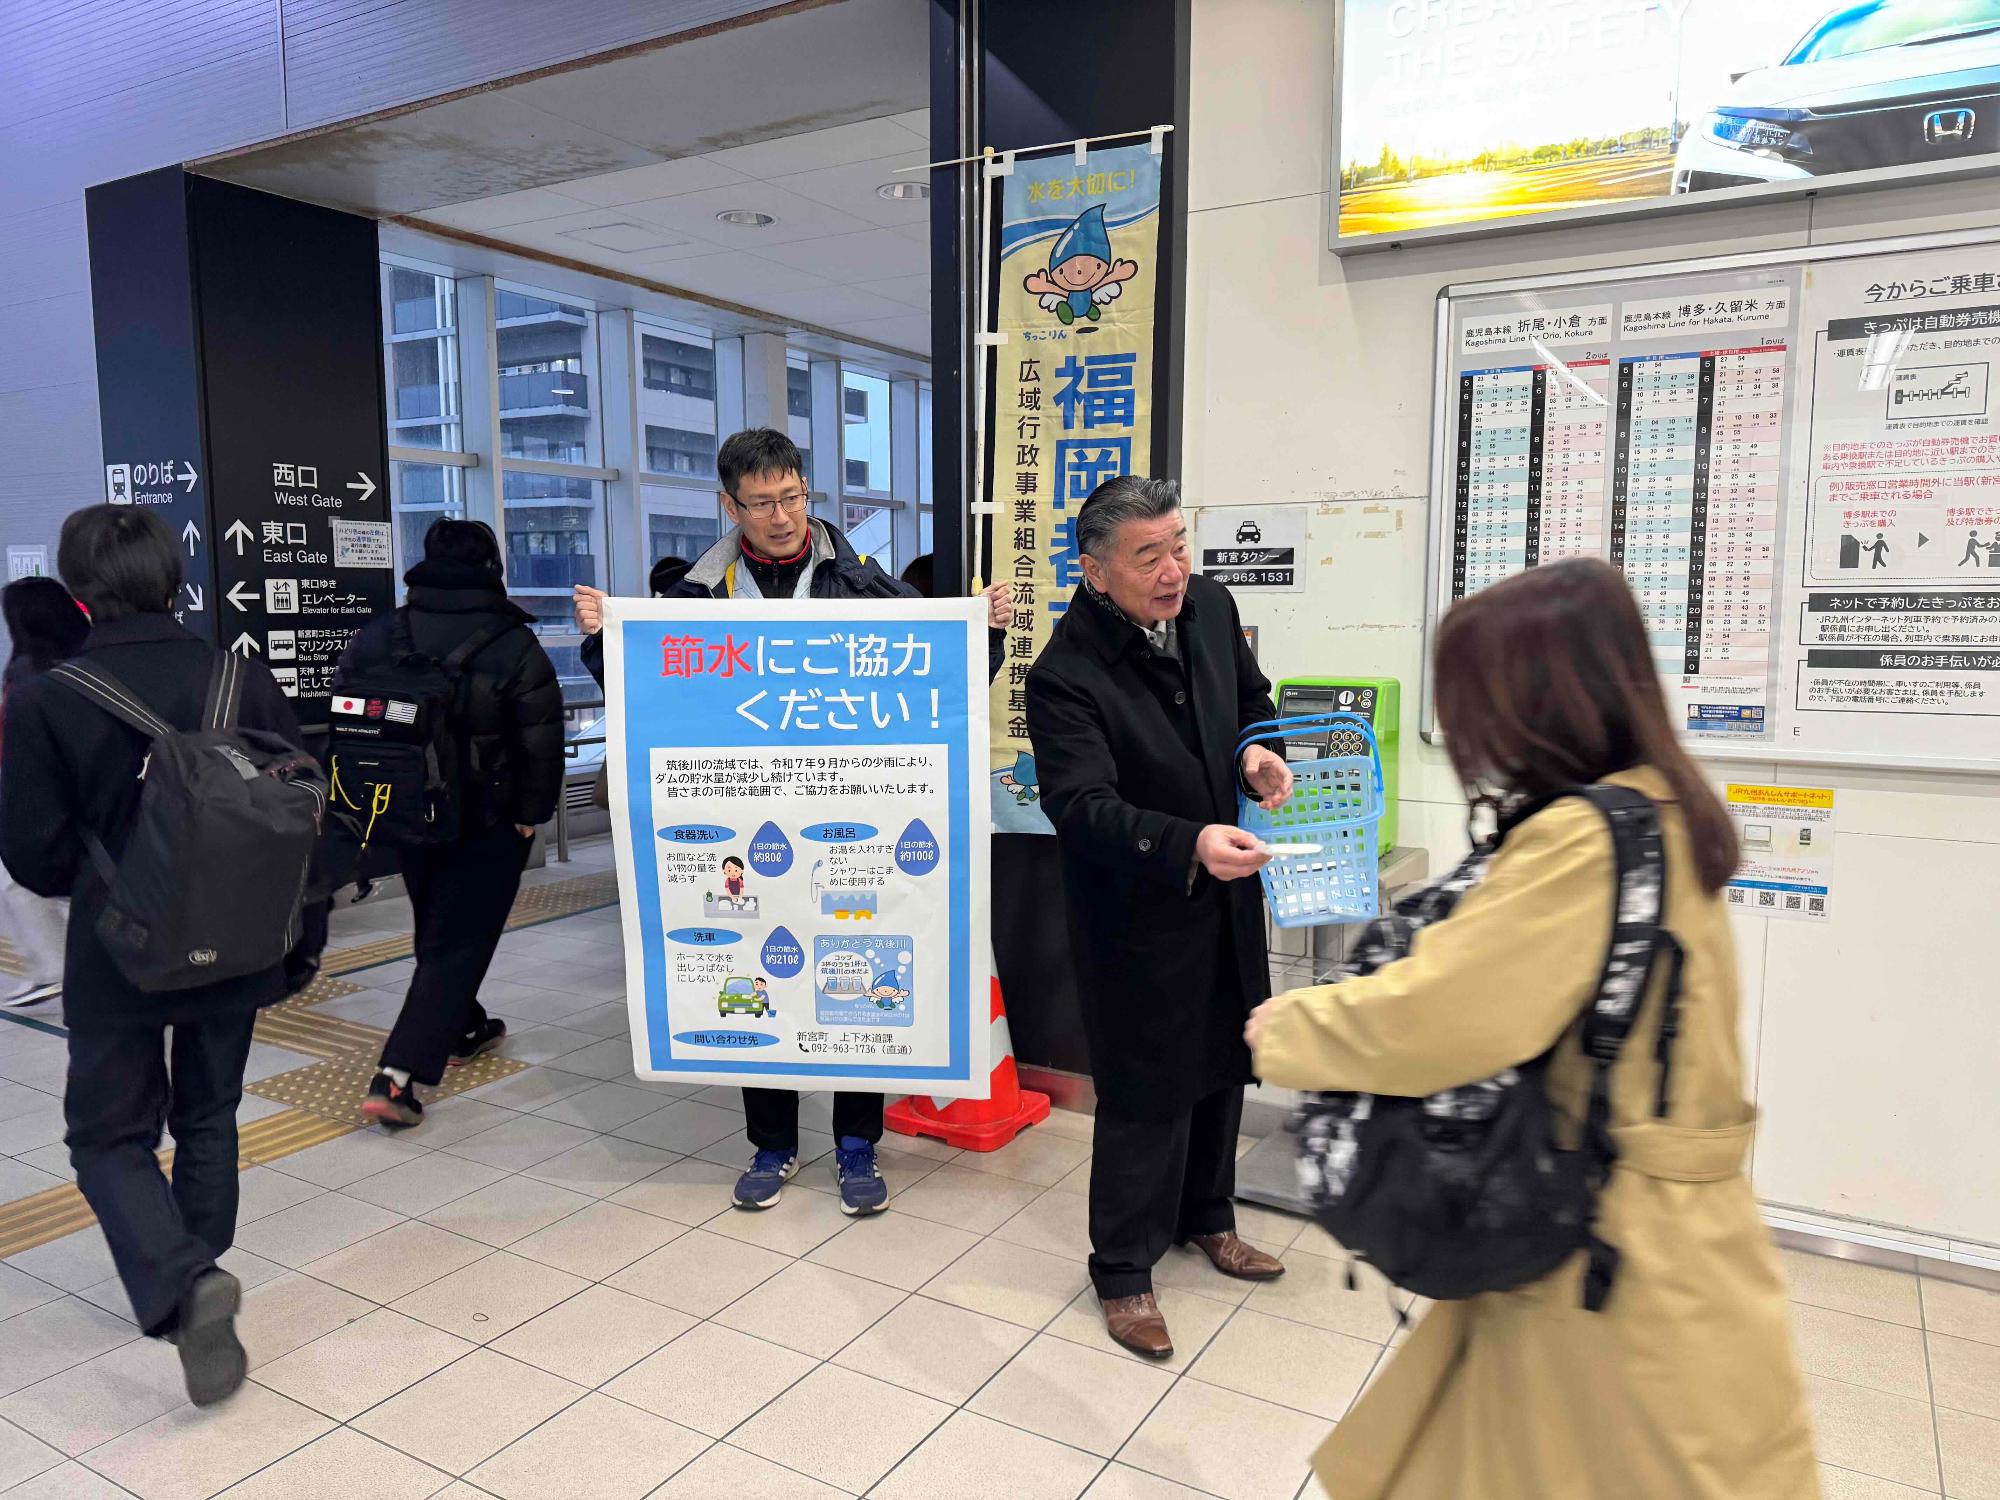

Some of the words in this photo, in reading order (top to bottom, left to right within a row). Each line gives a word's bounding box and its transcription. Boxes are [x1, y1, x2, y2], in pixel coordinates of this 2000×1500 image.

[1385, 0, 1575, 38] CREA
[1865, 273, 2000, 302] 今からご乗車
[1678, 299, 1758, 319] 博多・久留米
[1765, 300, 1786, 311] 方面
[1518, 315, 1581, 332] 折尾・小倉
[1588, 315, 1608, 326] 方面
[1624, 322, 1666, 333] Kagoshima
[1668, 320, 1686, 329] Line
[1688, 318, 1701, 327] for
[1737, 312, 1769, 323] Kurume
[1022, 330, 1068, 341] ちっこりん
[1465, 337, 1506, 348] Kagoshima
[1509, 335, 1527, 344] Line
[1564, 329, 1594, 339] Kokura
[1703, 397, 1708, 405] 7
[1823, 434, 2000, 452] ※目的地までのきっぷが自動券売機でお買
[133, 460, 174, 486] のりば
[273, 462, 319, 490] 西口
[135, 492, 173, 504] Entrance
[1048, 352, 1137, 633] 福岡
[274, 491, 308, 507] West
[311, 494, 343, 509] Gate
[261, 522, 307, 546] 東口
[263, 549, 293, 564] East
[295, 551, 328, 564] Gate
[1217, 551, 1280, 564] 新宮タクシー
[301, 579, 337, 589] 東口ゆき
[302, 594, 367, 605] エレベーター
[1817, 615, 2000, 624] ・JR九州インターネット列車予約で予約済みの
[1816, 633, 2000, 643] ・駅係員が不在の場合、列車内で乗務員にお申
[660, 633, 932, 679] 節水にご協力
[300, 677, 334, 689] にして
[736, 688, 940, 731] ください！
[1793, 726, 1801, 737] E
[655, 771, 846, 785] ダムの貯水量が減少し続けています。
[673, 829, 720, 841] 食器洗い
[822, 827, 857, 839] お風呂
[752, 841, 788, 851] 1日の節水
[829, 844, 896, 855] お湯を入れすぎ
[900, 840, 934, 850] 1日の節水
[666, 852, 717, 863] お皿など洗
[829, 856, 848, 866] ない
[666, 862, 717, 873] い物の量を
[829, 866, 895, 877] シャワーはこま
[667, 873, 698, 884] 減らす
[829, 876, 885, 887] めに使用する
[693, 931, 716, 942] 洗車
[765, 945, 799, 954] 1日の節水
[676, 952, 735, 963] ホースで水を
[677, 963, 734, 974] 出しっぱなし
[677, 973, 716, 984] にしない
[694, 1034, 759, 1046] 問い合わせ先
[796, 1031, 829, 1042] 新宮町
[839, 1032, 894, 1044] 上下水道課
[812, 1043, 876, 1054] 092-963-1736
